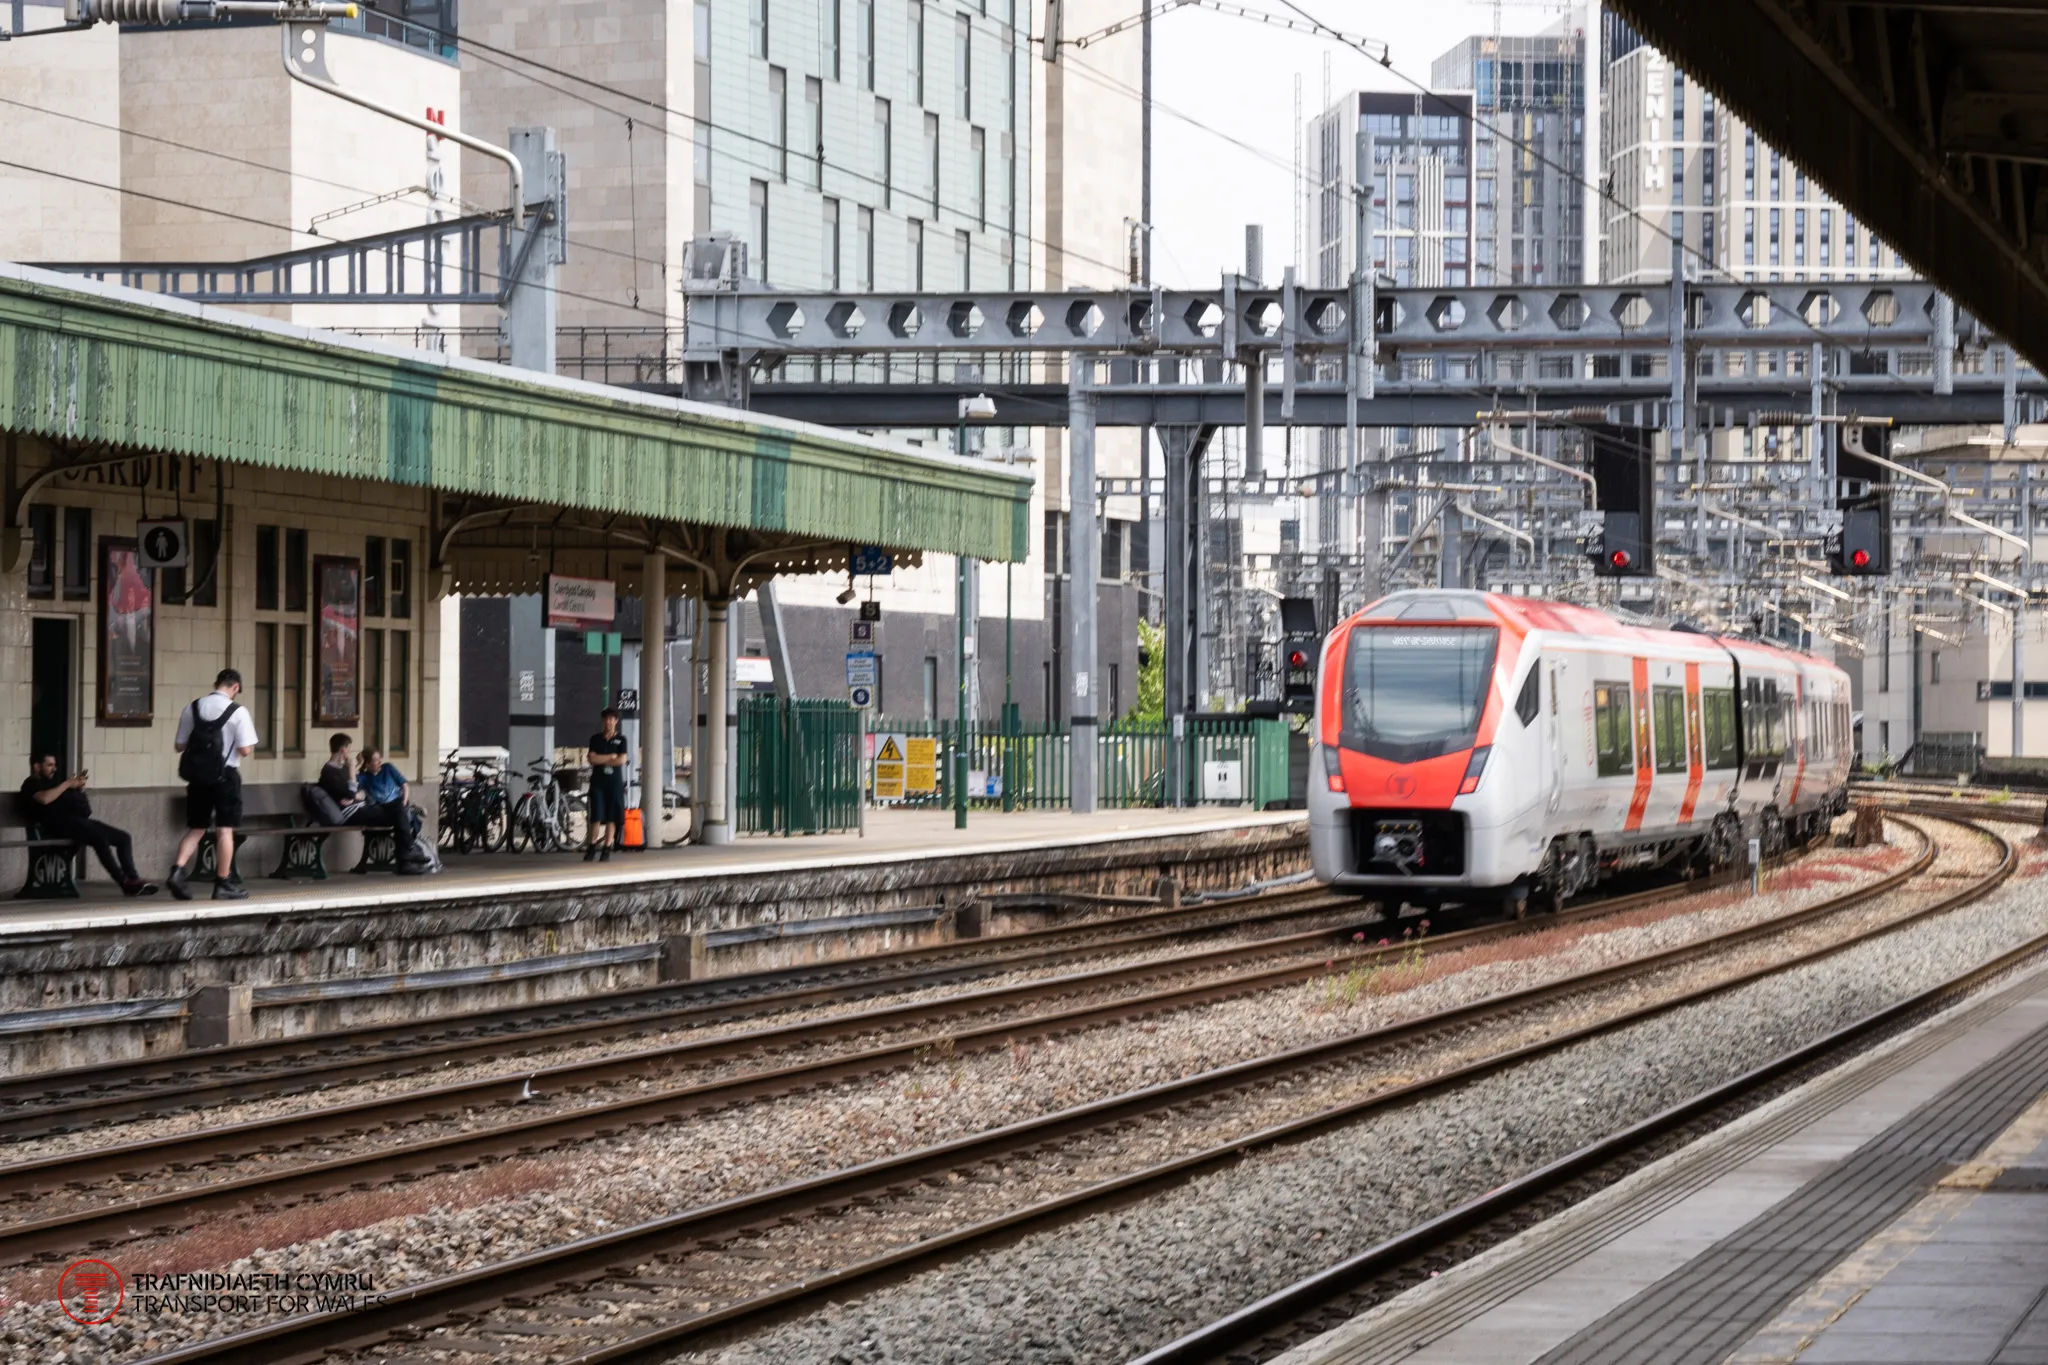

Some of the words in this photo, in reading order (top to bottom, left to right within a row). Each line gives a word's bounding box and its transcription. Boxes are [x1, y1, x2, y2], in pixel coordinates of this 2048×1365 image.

[1645, 47, 1666, 191] ZENITH
[289, 835, 318, 866] GWR
[368, 834, 396, 862] GWR
[34, 852, 67, 885] GWR
